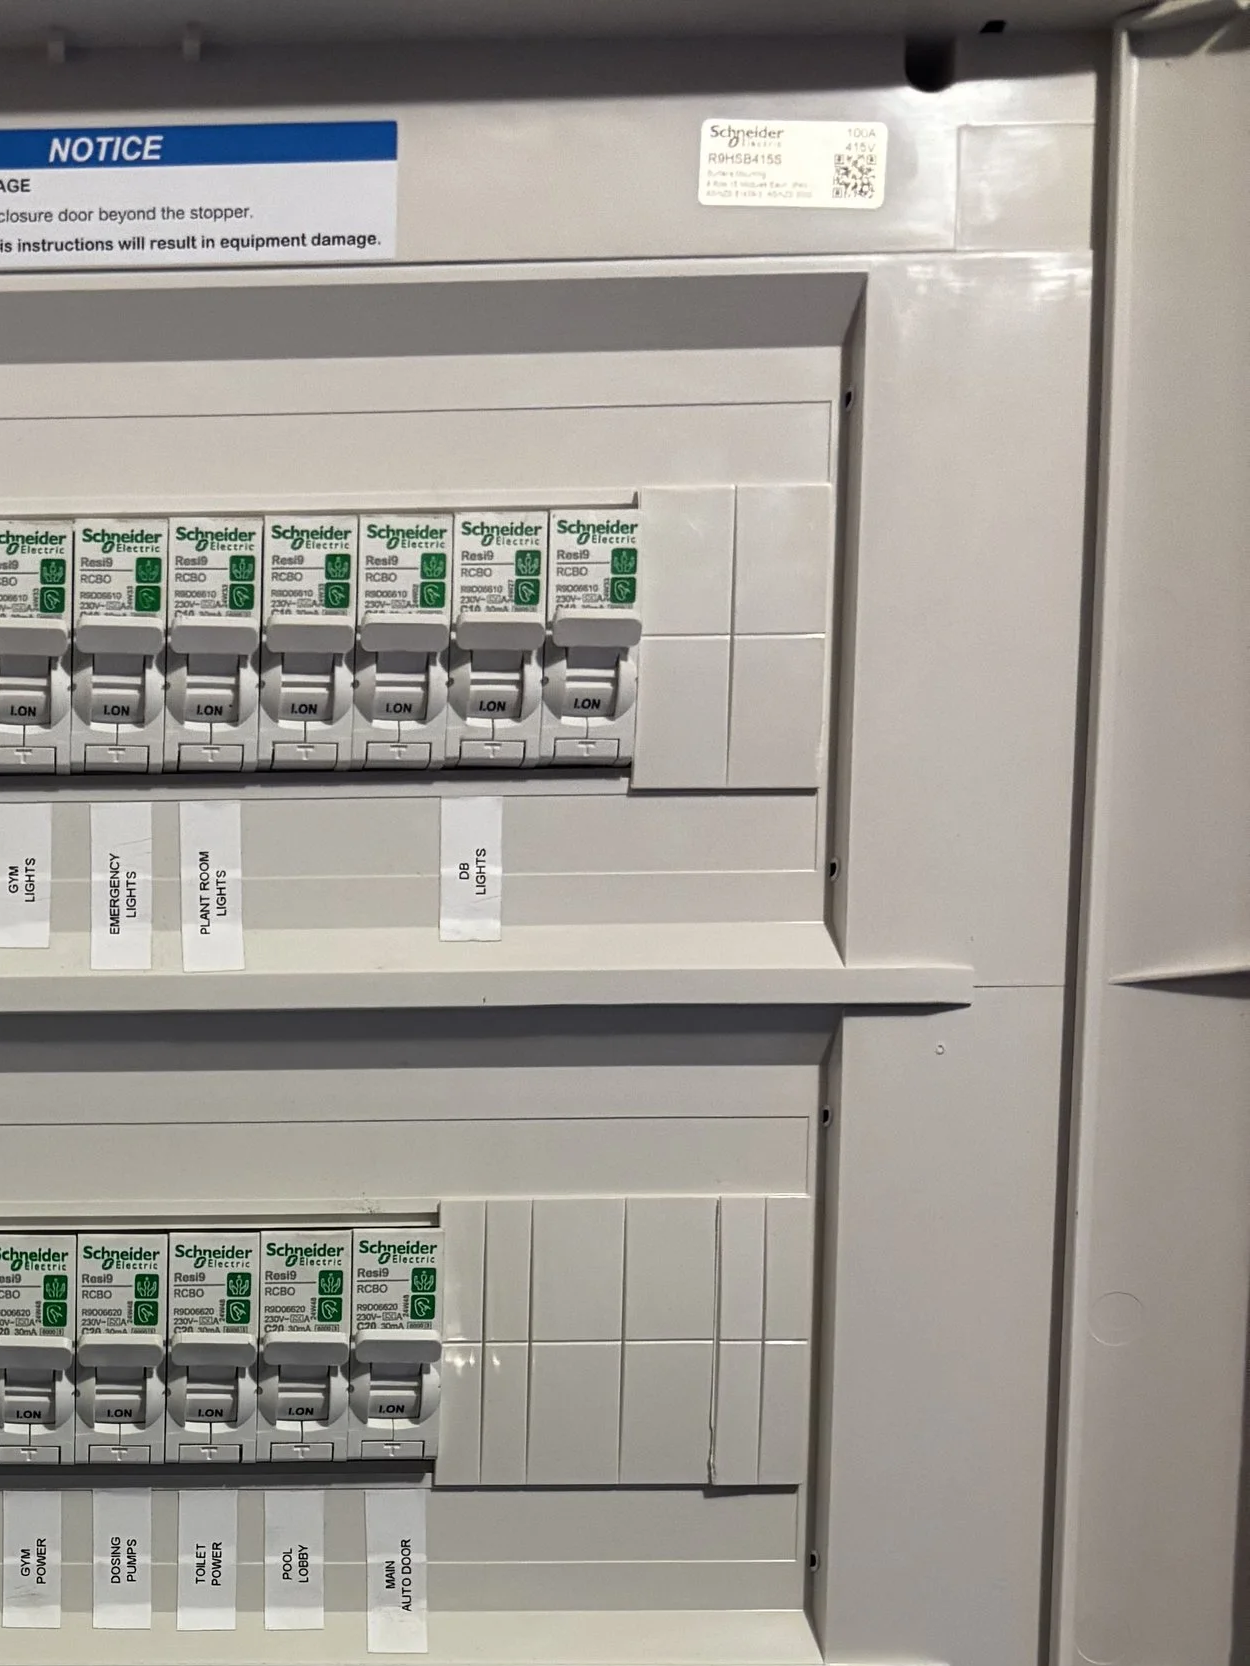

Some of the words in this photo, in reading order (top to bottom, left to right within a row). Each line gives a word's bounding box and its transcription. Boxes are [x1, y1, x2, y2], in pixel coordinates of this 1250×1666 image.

[710, 125, 784, 139] Schneider
[50, 136, 163, 162] NOTICE
[57, 208, 94, 222] door
[98, 206, 156, 225] beyond
[160, 206, 185, 221] the
[189, 205, 254, 225] stopper.
[17, 237, 114, 253] instructions
[117, 236, 145, 251] will
[149, 235, 197, 250] result
[201, 235, 215, 249] in
[219, 232, 307, 252] equipment
[310, 232, 381, 250] damage.
[82, 528, 162, 544] Schneider
[176, 527, 256, 542] Schneider
[272, 525, 352, 541] Schneider
[367, 524, 447, 540] Schneider
[461, 521, 542, 537] Schneider
[557, 520, 638, 536] Schneider
[20, 543, 66, 555] Electric
[495, 537, 540, 547] Electric
[460, 567, 492, 578] RCBO
[8, 865, 19, 894] GYM
[24, 857, 36, 903] LIGHTS
[198, 851, 210, 891] ROOM
[458, 862, 470, 880] DB
[475, 847, 487, 896] LIGHTS
[109, 852, 121, 935] EMERGENCY
[125, 871, 137, 918] LIGHTS
[215, 870, 227, 917] LIGHTS
[199, 894, 211, 935] PLANT
[82, 1246, 160, 1261] Schneider
[174, 1245, 252, 1260] Schneider
[266, 1242, 344, 1258] Schneider
[359, 1240, 437, 1256] Schneider
[24, 1261, 68, 1272] Electric
[20, 1548, 31, 1577] GYM
[36, 1538, 47, 1585] POWER
[110, 1536, 121, 1584] DOSING
[126, 1538, 137, 1582] PUMPS
[195, 1543, 207, 1585] TOILET
[211, 1541, 223, 1587] POWER
[282, 1548, 293, 1581] POOL
[297, 1544, 309, 1583] LOBBY
[400, 1538, 412, 1575] DOOR
[384, 1560, 396, 1589] MAIN
[401, 1577, 412, 1612] AUTO
